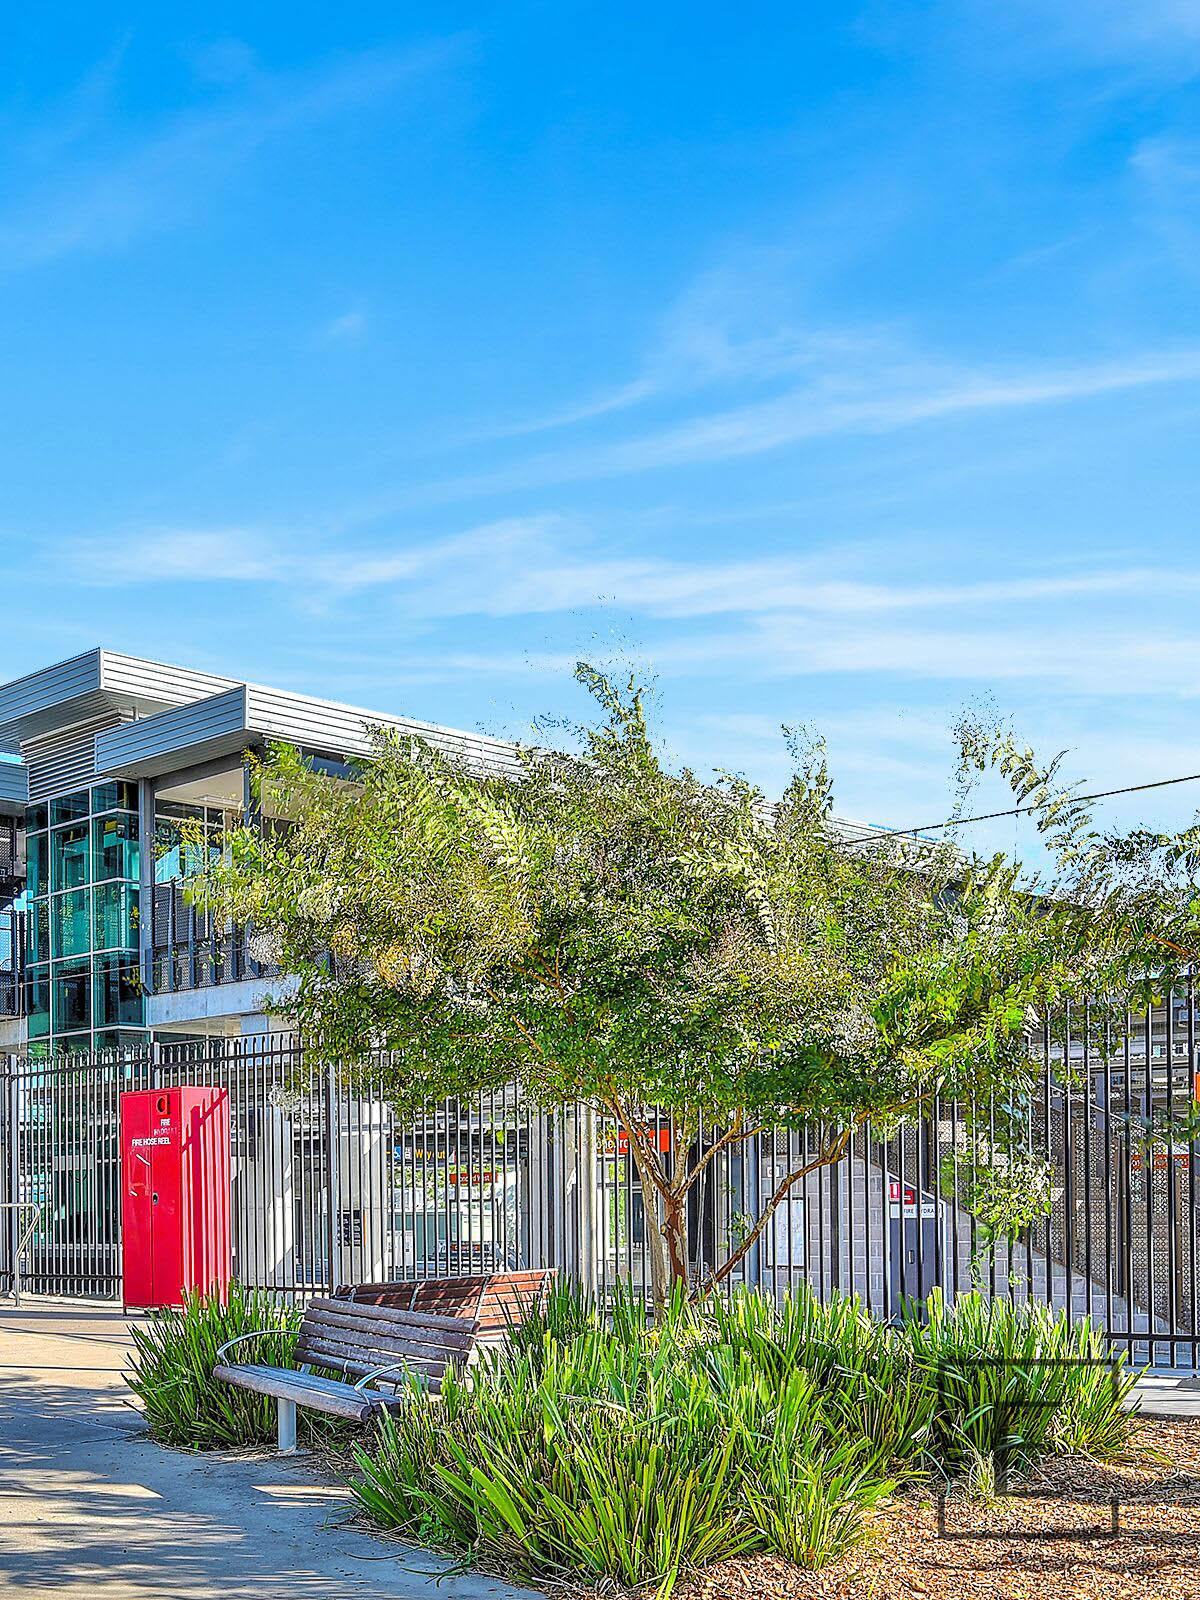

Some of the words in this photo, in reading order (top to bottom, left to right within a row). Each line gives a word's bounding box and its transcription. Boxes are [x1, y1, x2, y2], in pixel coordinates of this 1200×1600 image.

[160, 1118, 171, 1127] FIRE
[132, 1138, 143, 1147] FIRE
[143, 1137, 158, 1146] HOSE
[158, 1136, 171, 1145] REEL
[415, 1149, 432, 1160] Wy
